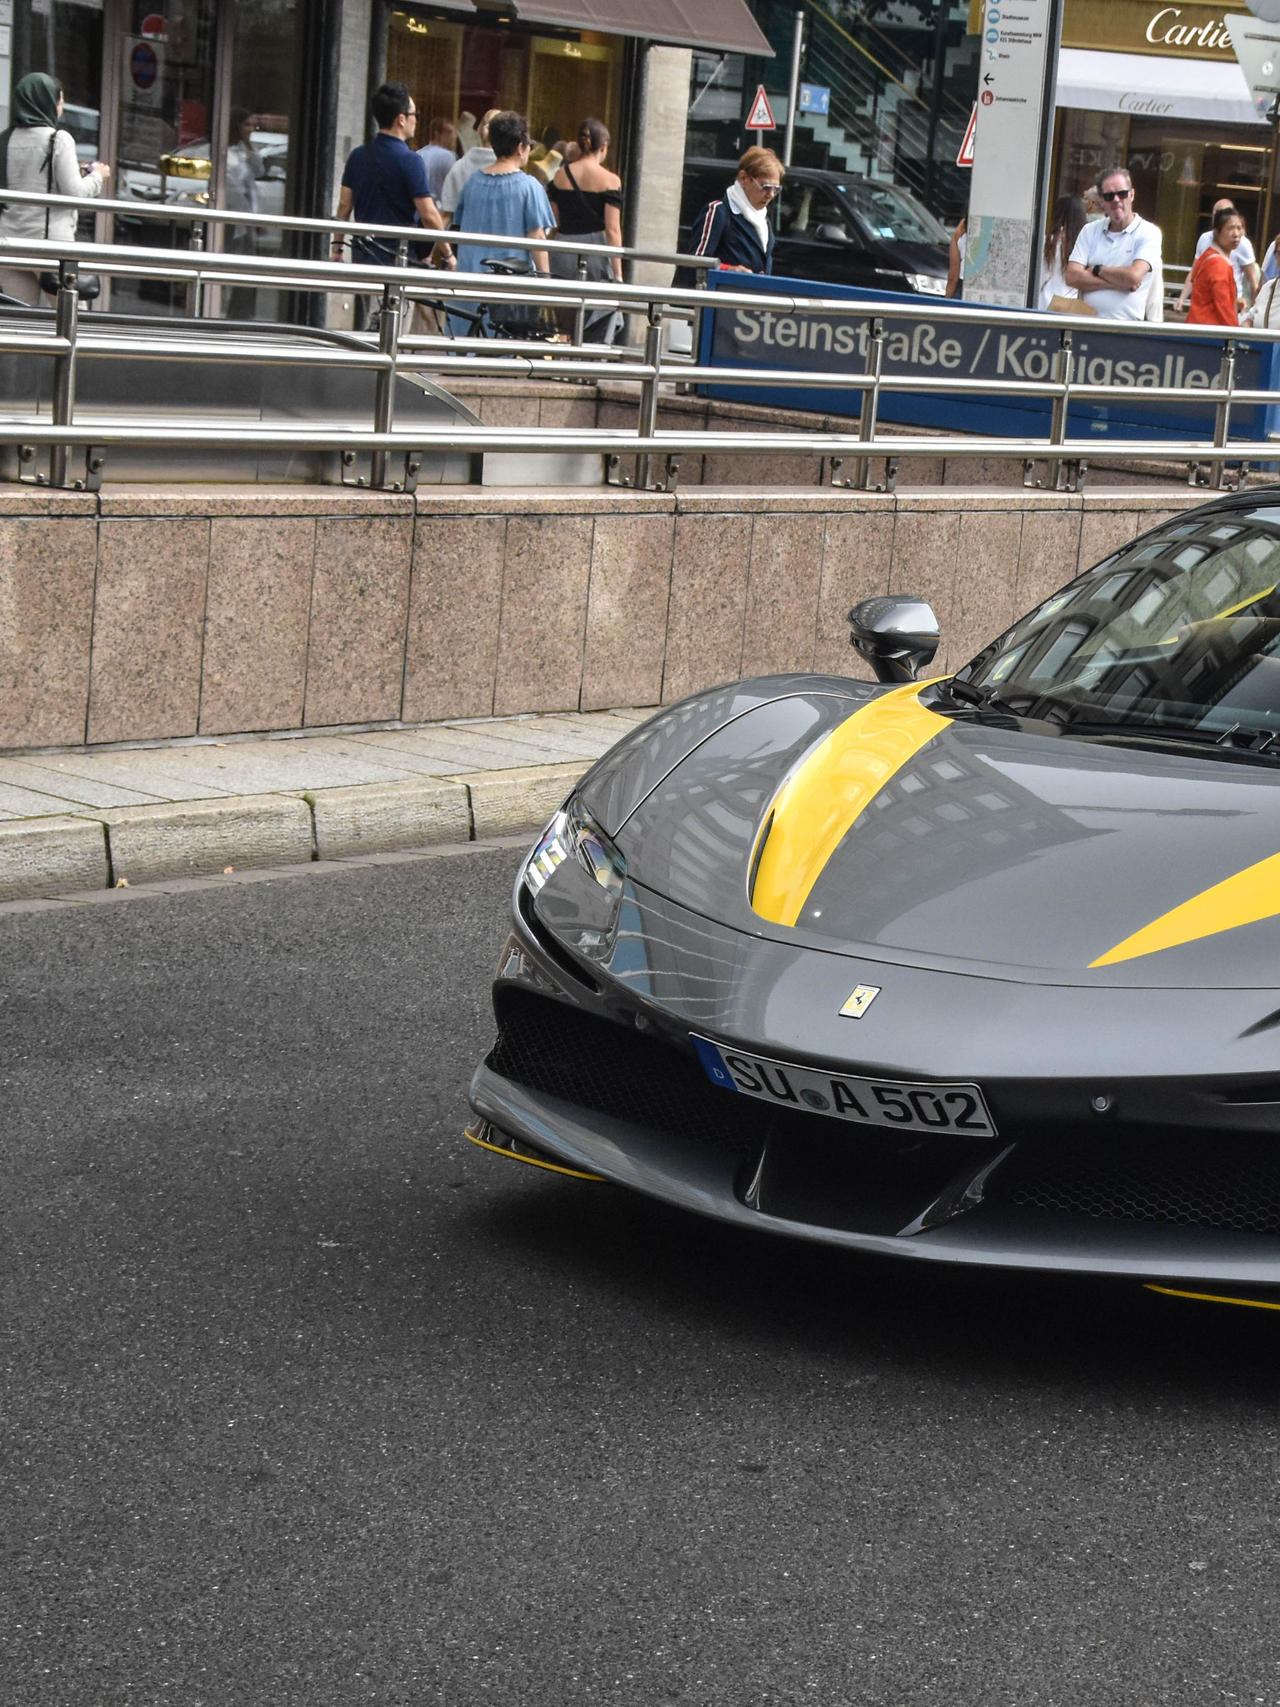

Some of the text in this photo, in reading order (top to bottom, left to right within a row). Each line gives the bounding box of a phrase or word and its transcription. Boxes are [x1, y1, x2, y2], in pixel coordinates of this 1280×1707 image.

[1000, 30, 1032, 38] Kunstsammlung
[1145, 7, 1235, 49] Cartie
[995, 95, 1027, 103] Johanneskirche
[1118, 91, 1174, 114] Cartier
[714, 1067, 725, 1079] D
[725, 1055, 987, 1129] SU A 502
